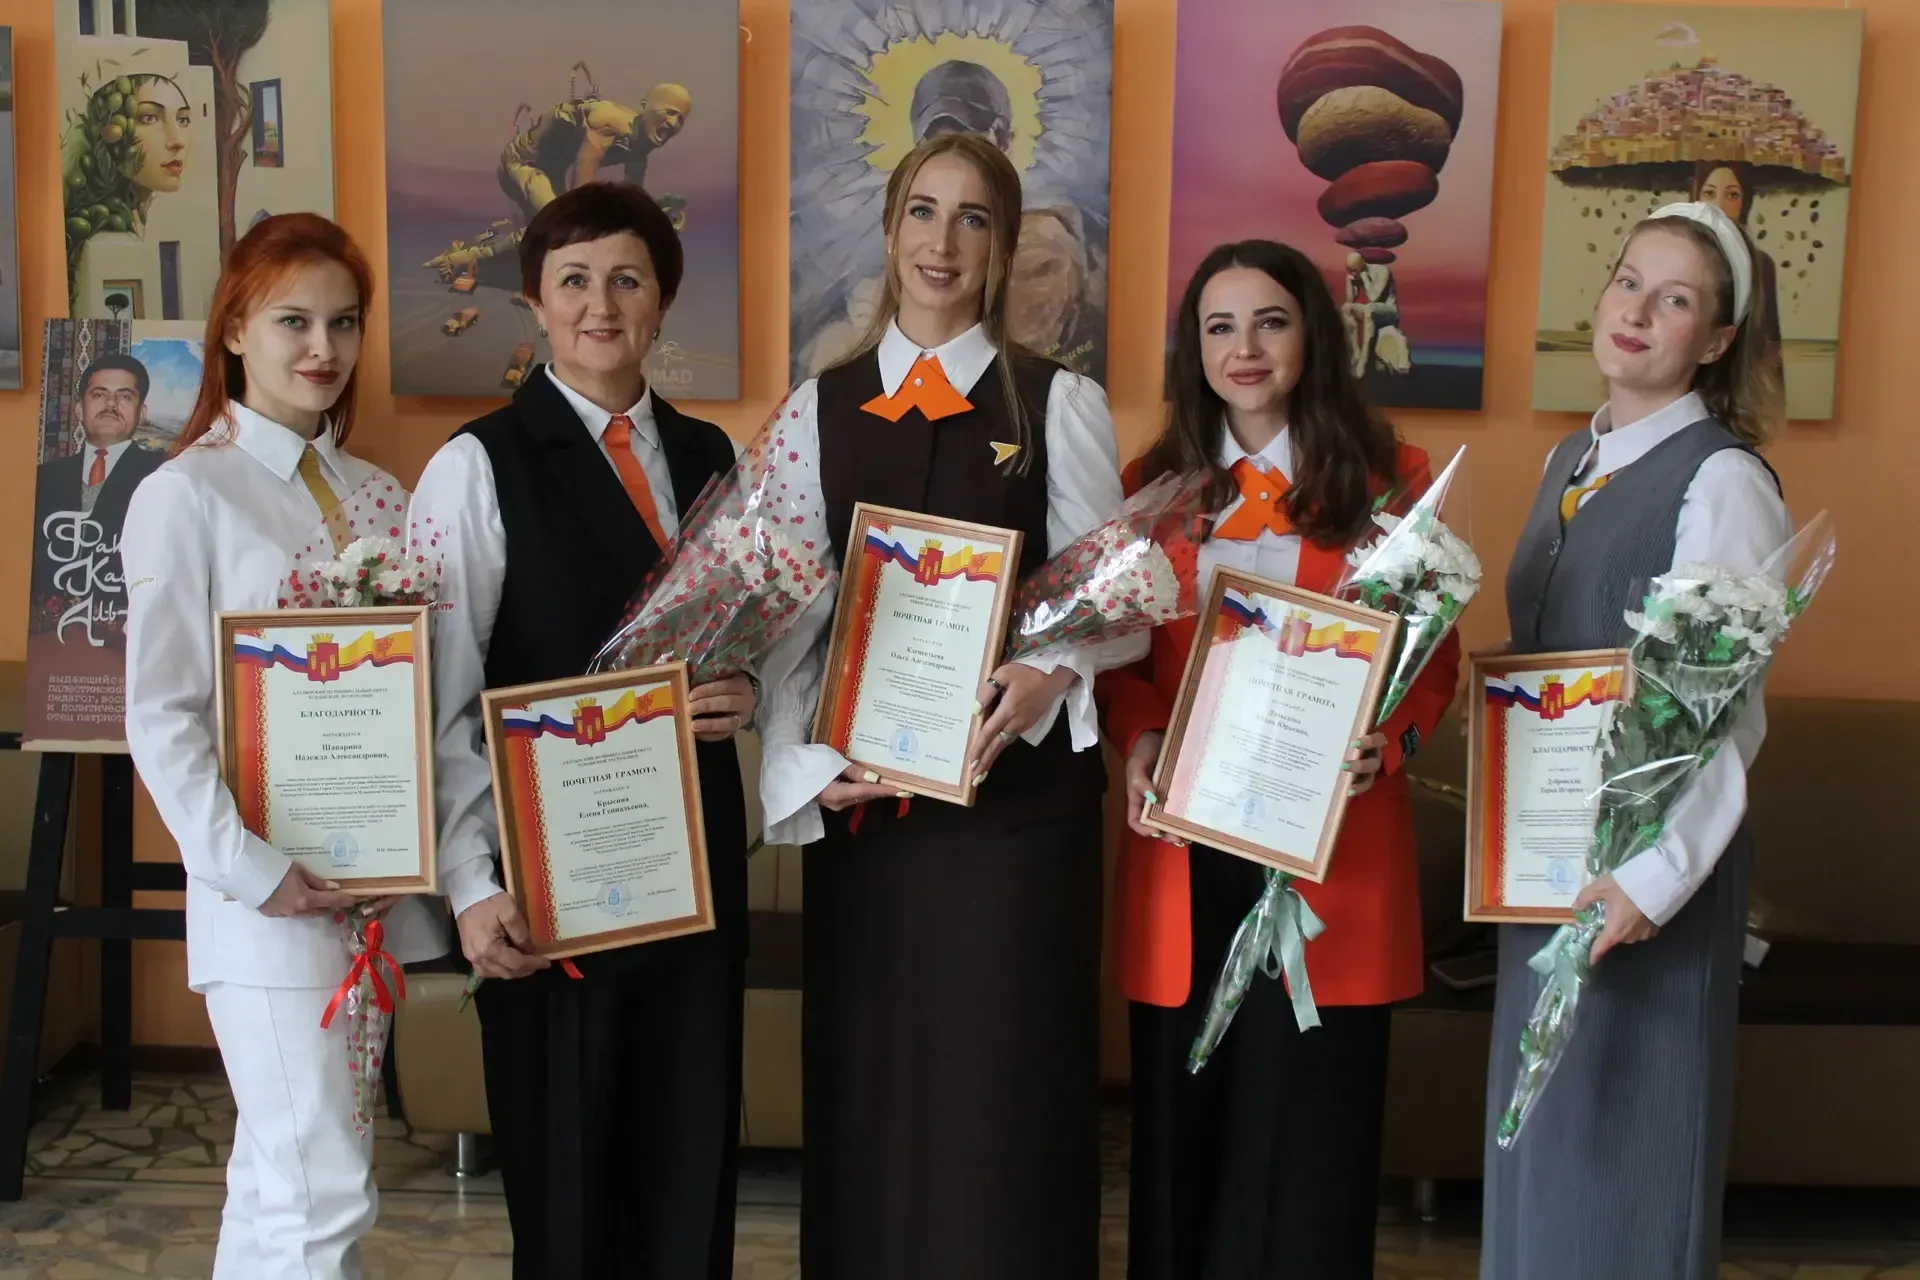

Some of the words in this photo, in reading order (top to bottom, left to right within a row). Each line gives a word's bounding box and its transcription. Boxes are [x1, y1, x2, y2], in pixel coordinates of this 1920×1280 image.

[893, 610, 932, 625] ПОЧЕТНАЯ
[935, 620, 970, 634] ГРАМОТА
[48, 694, 98, 704] педагог,
[1296, 690, 1336, 709] ГРАМОТА
[46, 712, 74, 722] отец
[300, 708, 382, 718] БЛАГОДАРНОСТЬ
[562, 773, 612, 788] ПОЧЕТНАЯ
[615, 766, 658, 778] ГРАМОТА
[579, 809, 601, 819] Елена
